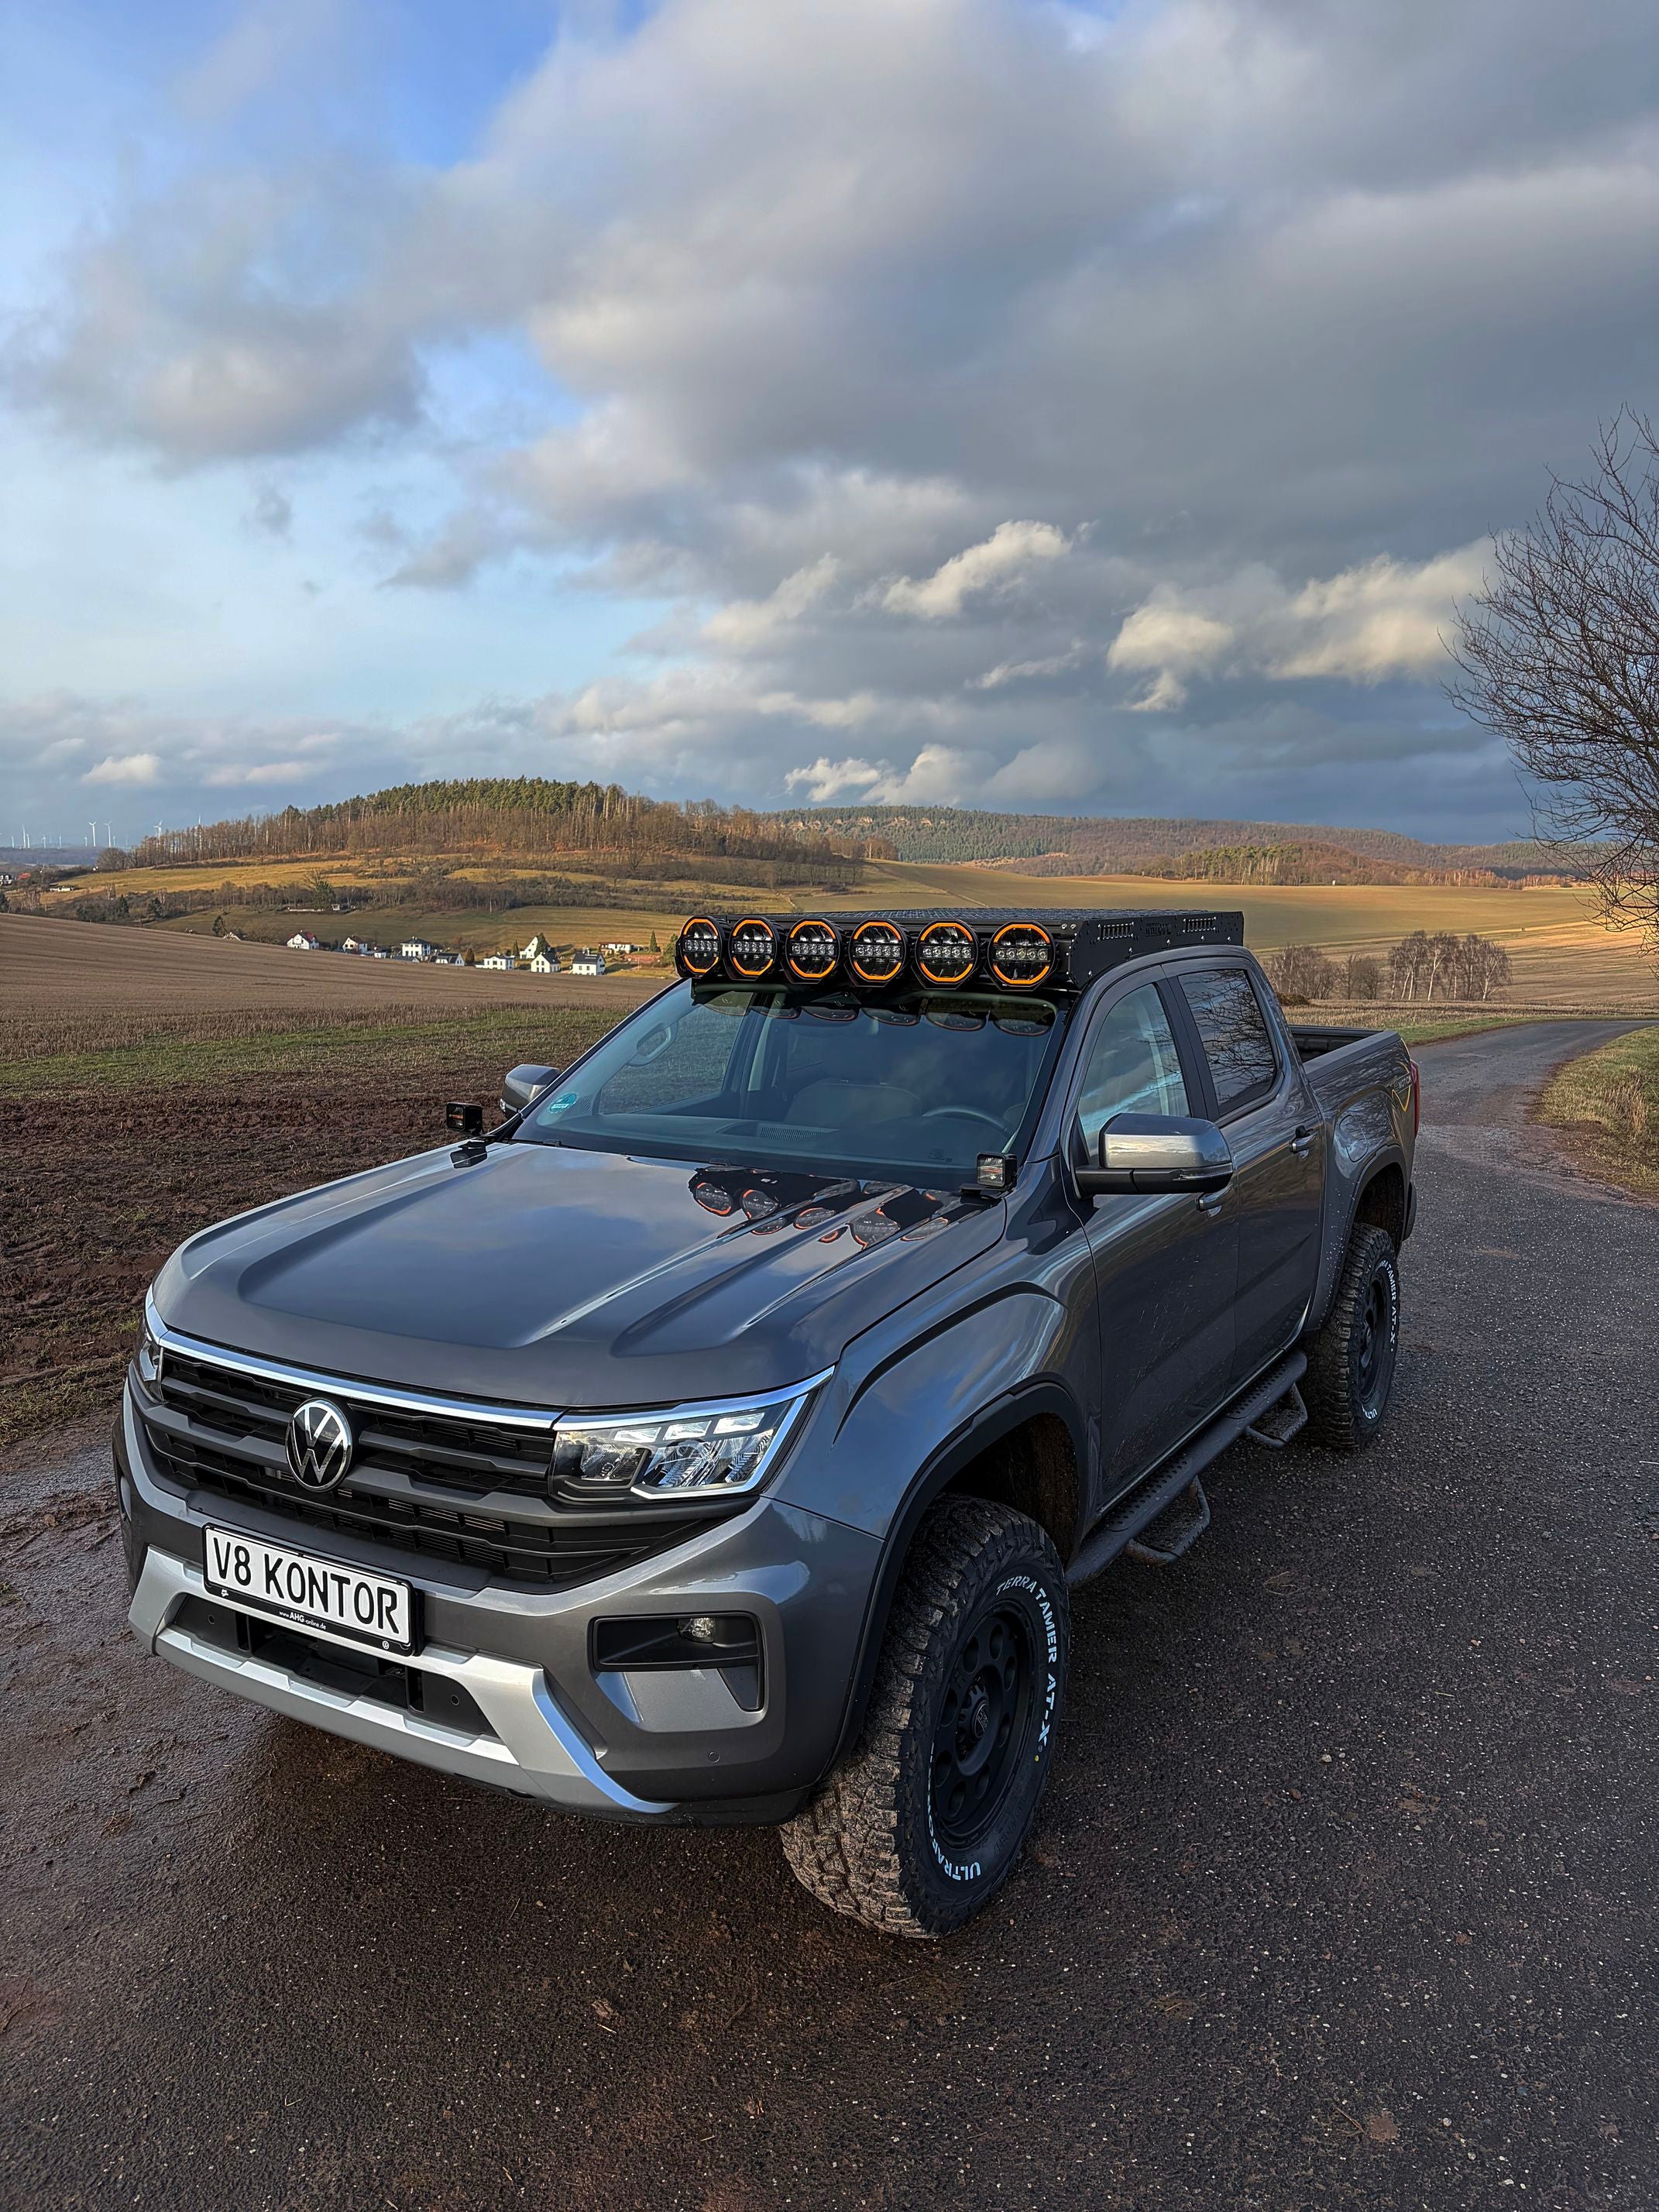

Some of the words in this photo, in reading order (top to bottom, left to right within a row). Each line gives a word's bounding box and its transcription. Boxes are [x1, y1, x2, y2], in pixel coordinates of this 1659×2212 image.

[213, 1537, 252, 1586] V8
[264, 1553, 400, 1634] KONTOR
[995, 1575, 1038, 1596] TERRA
[1036, 1588, 1057, 1664] TAMER
[1038, 1673, 1056, 1747] AT-X
